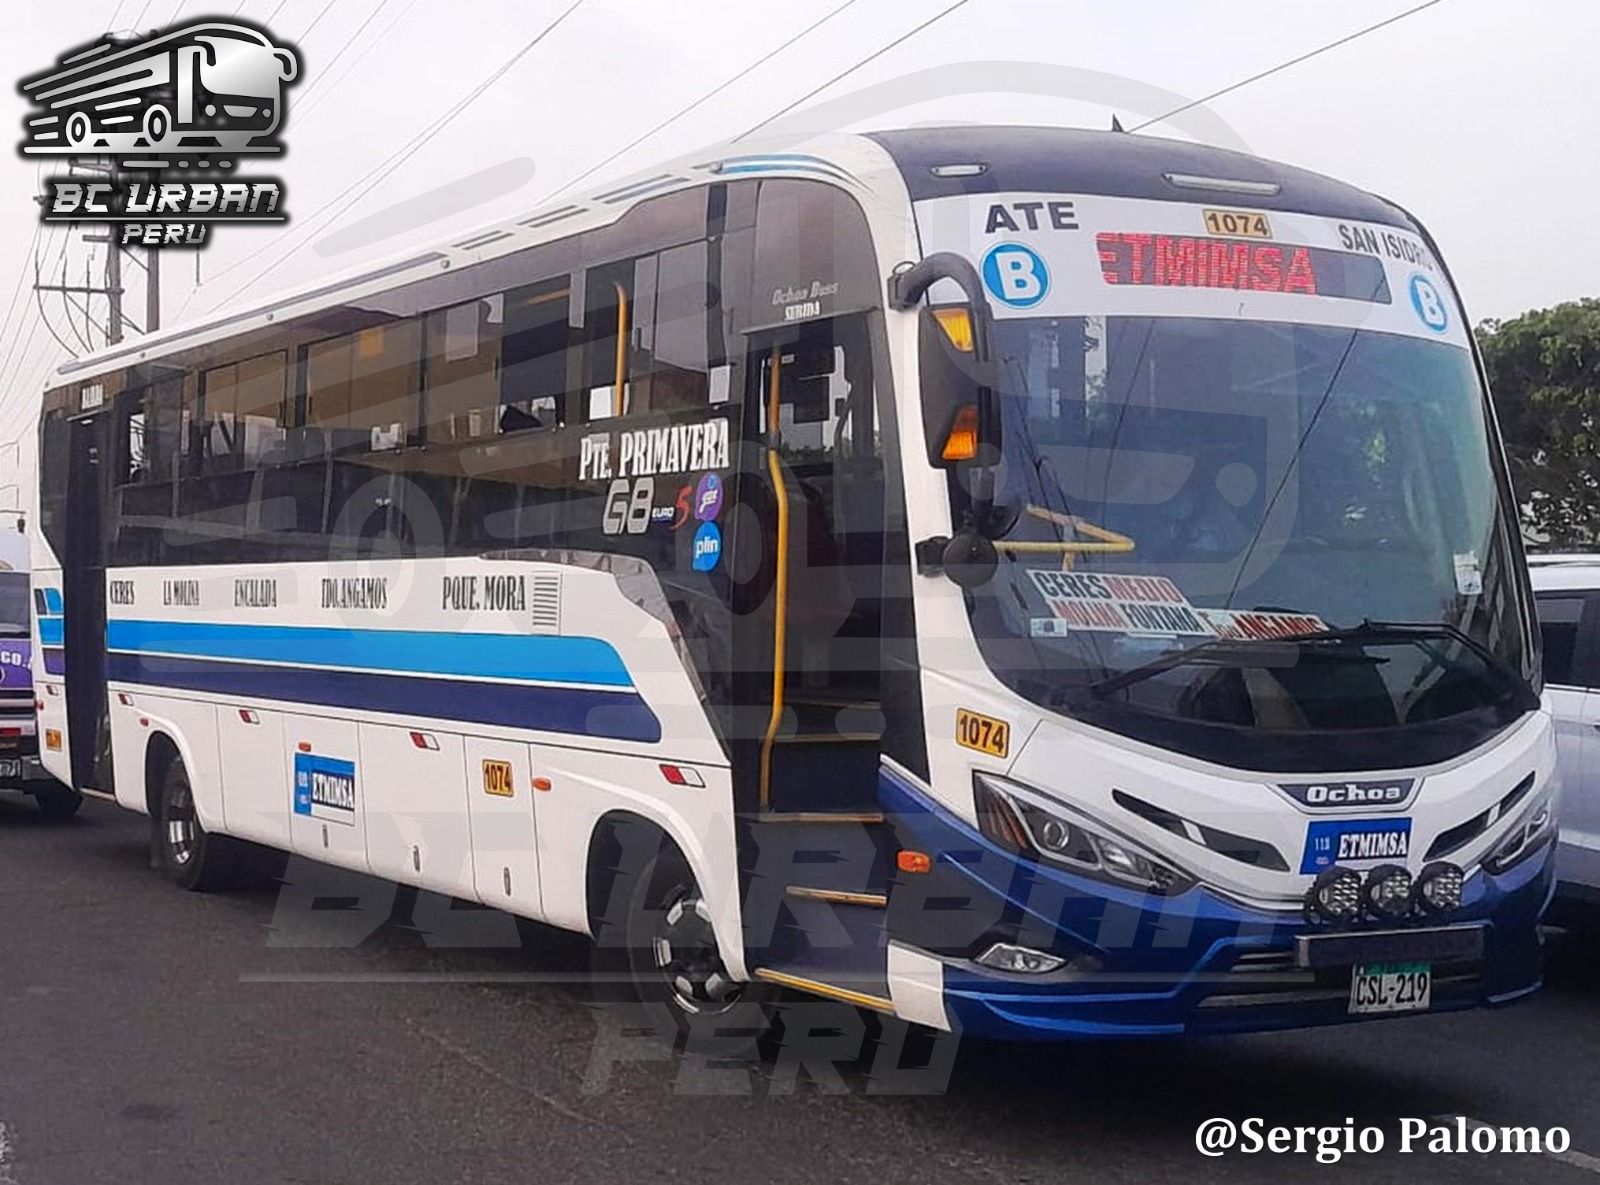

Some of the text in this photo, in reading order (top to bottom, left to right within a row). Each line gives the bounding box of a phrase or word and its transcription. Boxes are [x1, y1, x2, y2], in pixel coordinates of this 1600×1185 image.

[985, 202, 1079, 233] ATE
[1206, 212, 1268, 236] 1074
[1339, 225, 1380, 254] SAN
[995, 251, 1041, 300] B
[1096, 232, 1316, 295] ETMIMSA
[1414, 280, 1445, 327] B
[579, 420, 730, 480] PTE. PRIMAVERA
[669, 485, 693, 530] 5
[695, 536, 719, 559] plin
[110, 580, 135, 605] CERES
[484, 576, 526, 611] MORA
[1034, 572, 1183, 602] CERES MEDIO
[1053, 600, 1205, 633] MOLINA FONTANA
[960, 714, 1005, 752] 1074
[484, 762, 511, 793] 1074
[1307, 784, 1400, 802] Ochoa
[1338, 832, 1407, 858] ETMIMSA
[1357, 973, 1427, 1005] CSL-219
